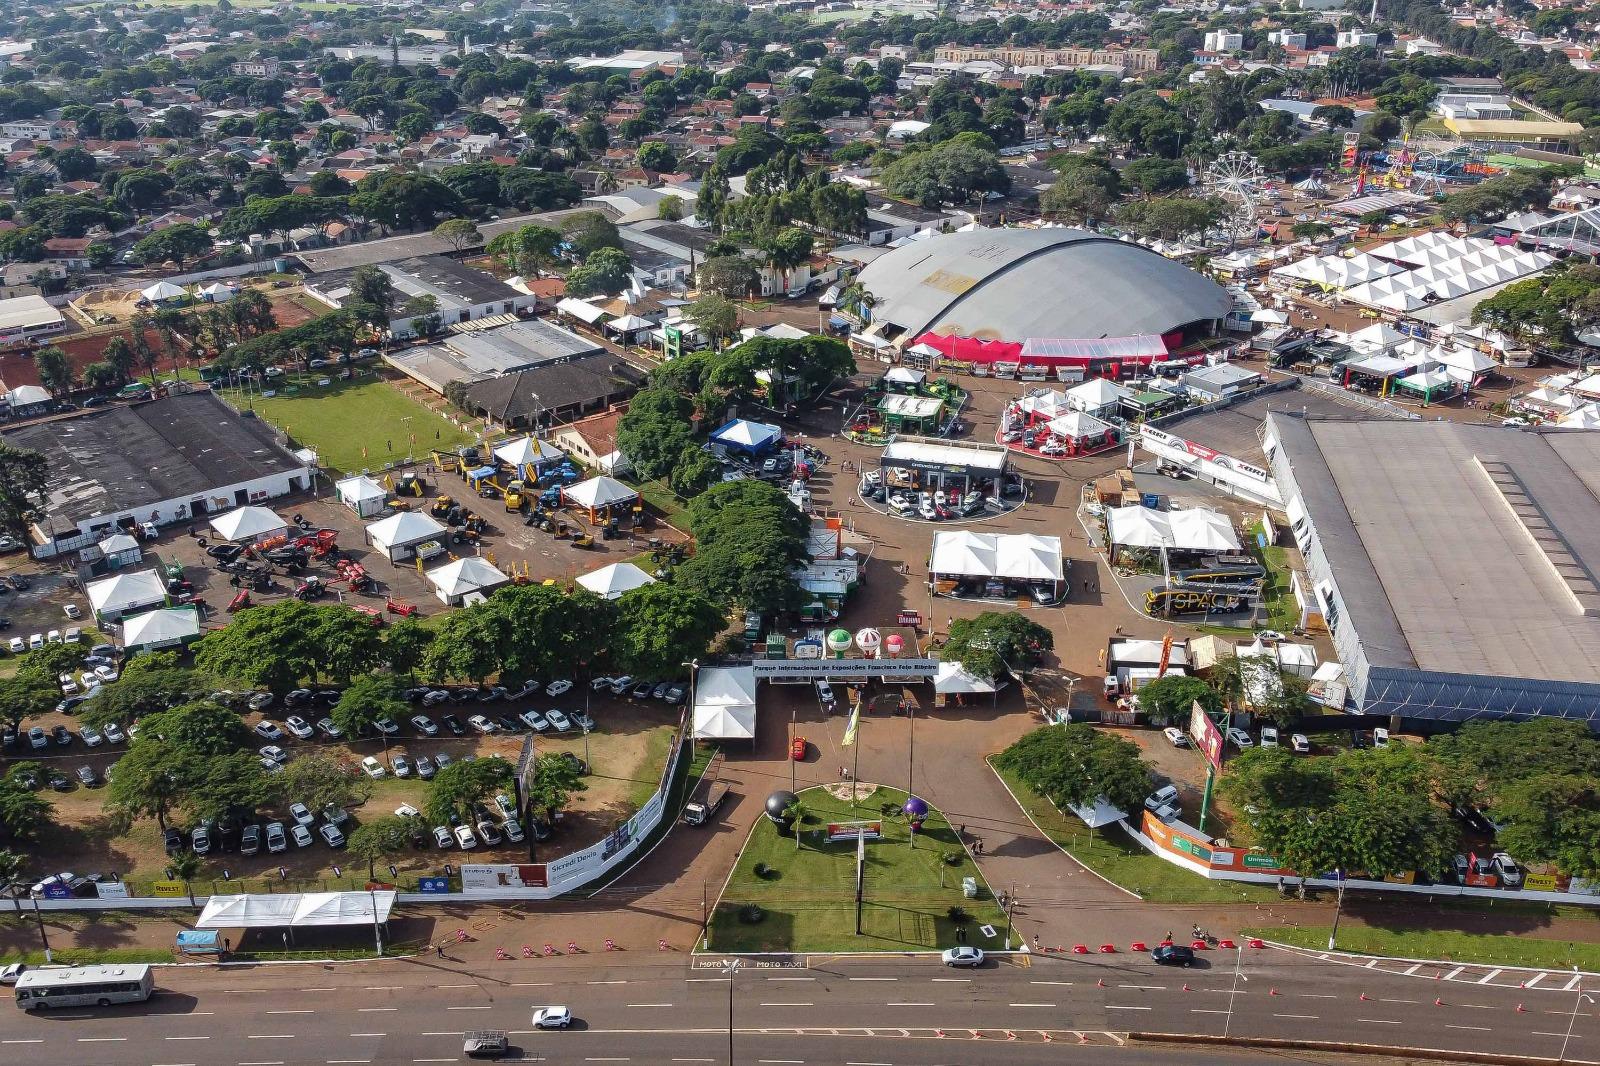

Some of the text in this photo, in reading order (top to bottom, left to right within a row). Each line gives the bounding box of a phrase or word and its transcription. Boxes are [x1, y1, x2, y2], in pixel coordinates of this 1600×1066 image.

[911, 462, 941, 470] CHEVROLET
[832, 664, 866, 672] Exposições
[551, 858, 576, 872] Sicredi
